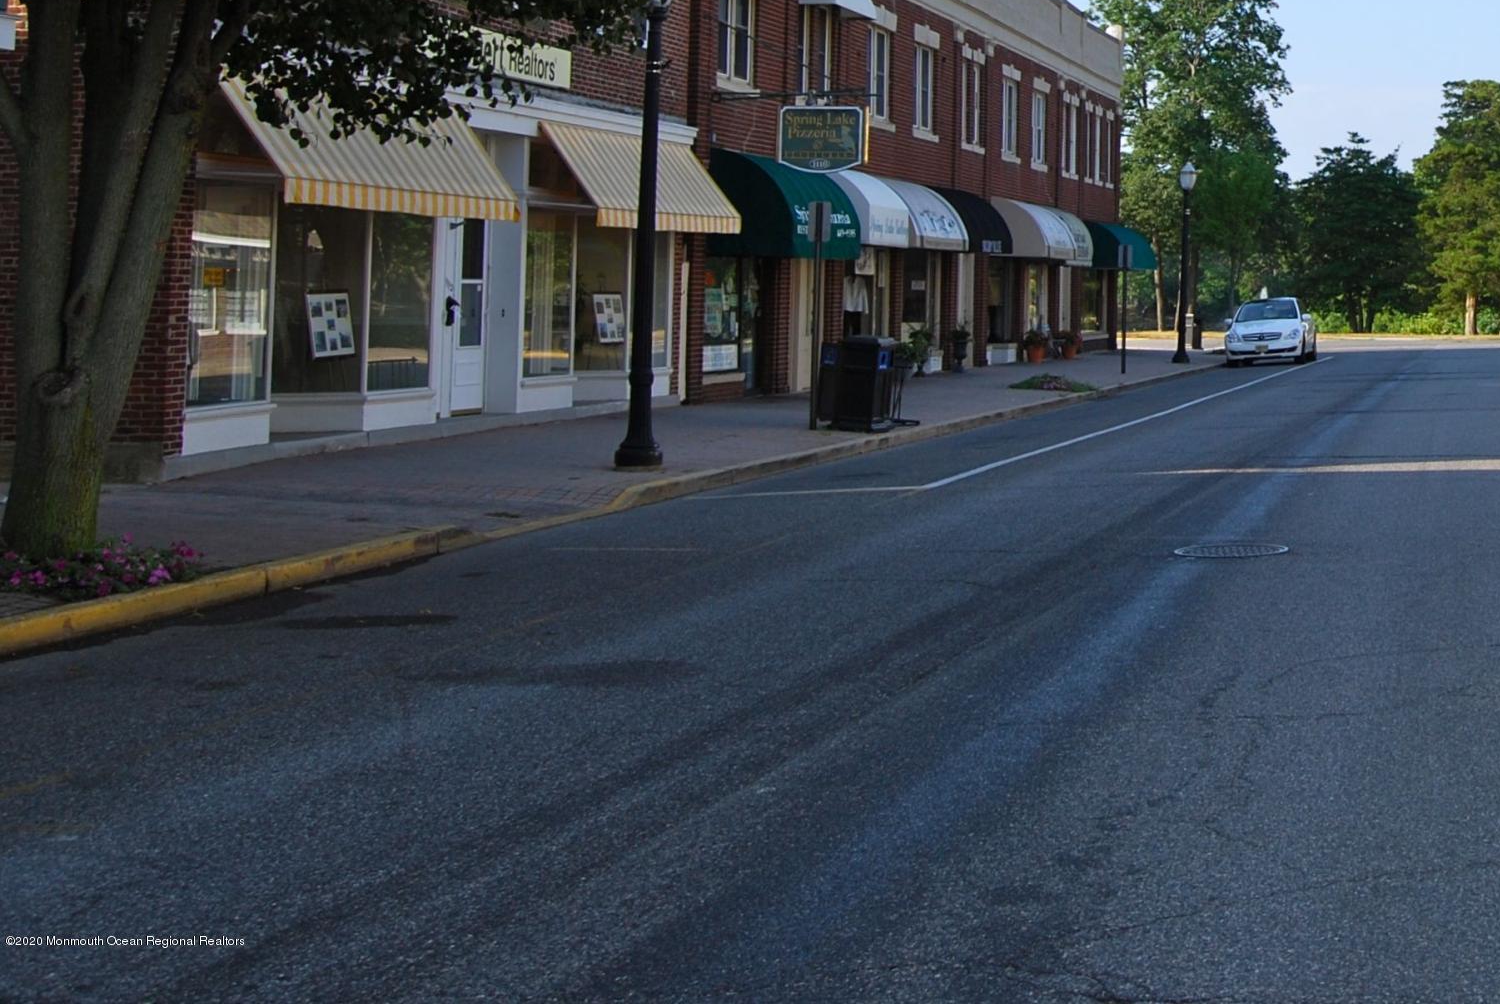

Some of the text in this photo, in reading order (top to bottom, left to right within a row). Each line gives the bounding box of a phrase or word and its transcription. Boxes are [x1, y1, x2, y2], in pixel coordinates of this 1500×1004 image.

[785, 112, 856, 126] Spring Lake
[787, 125, 837, 139] Pizzeria
